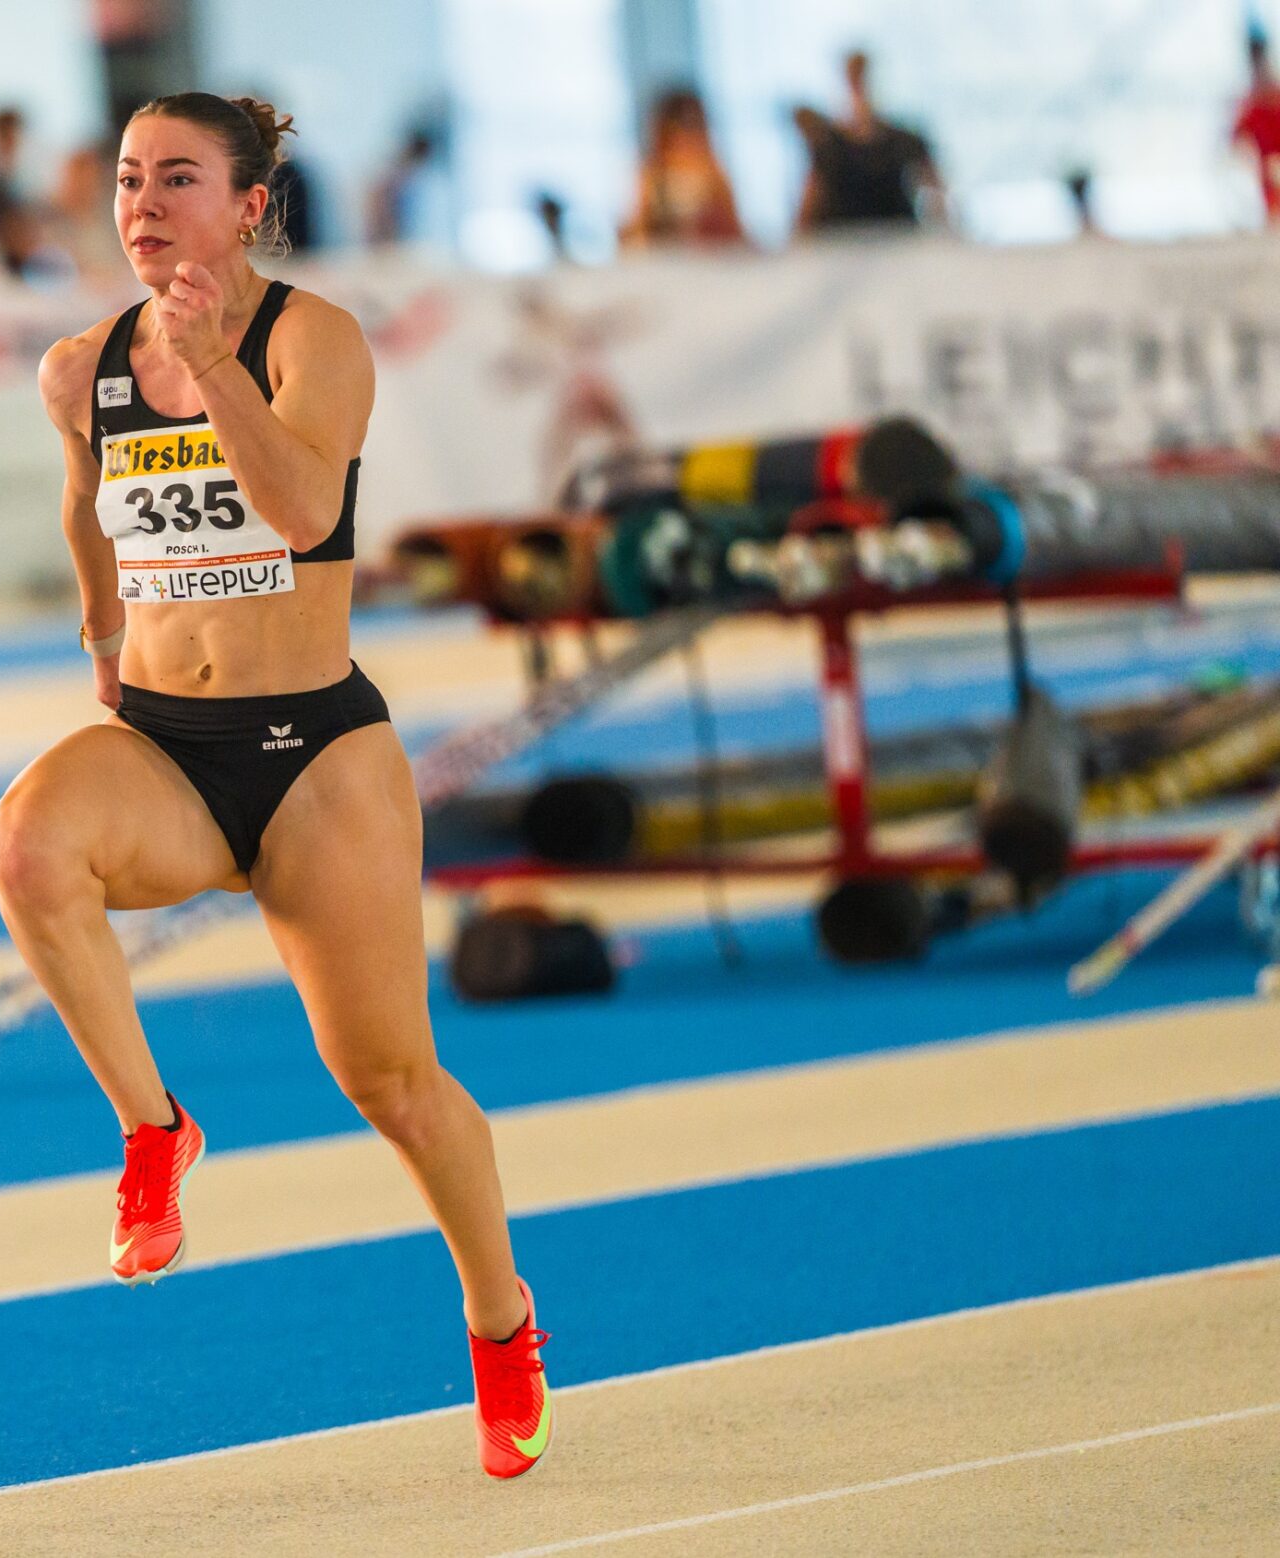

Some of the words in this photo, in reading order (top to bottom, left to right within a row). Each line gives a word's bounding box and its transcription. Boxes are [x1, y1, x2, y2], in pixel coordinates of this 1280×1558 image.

[124, 479, 246, 535] 335
[166, 545, 199, 555] POSCH
[201, 543, 210, 553] I.
[262, 738, 304, 750] erima
